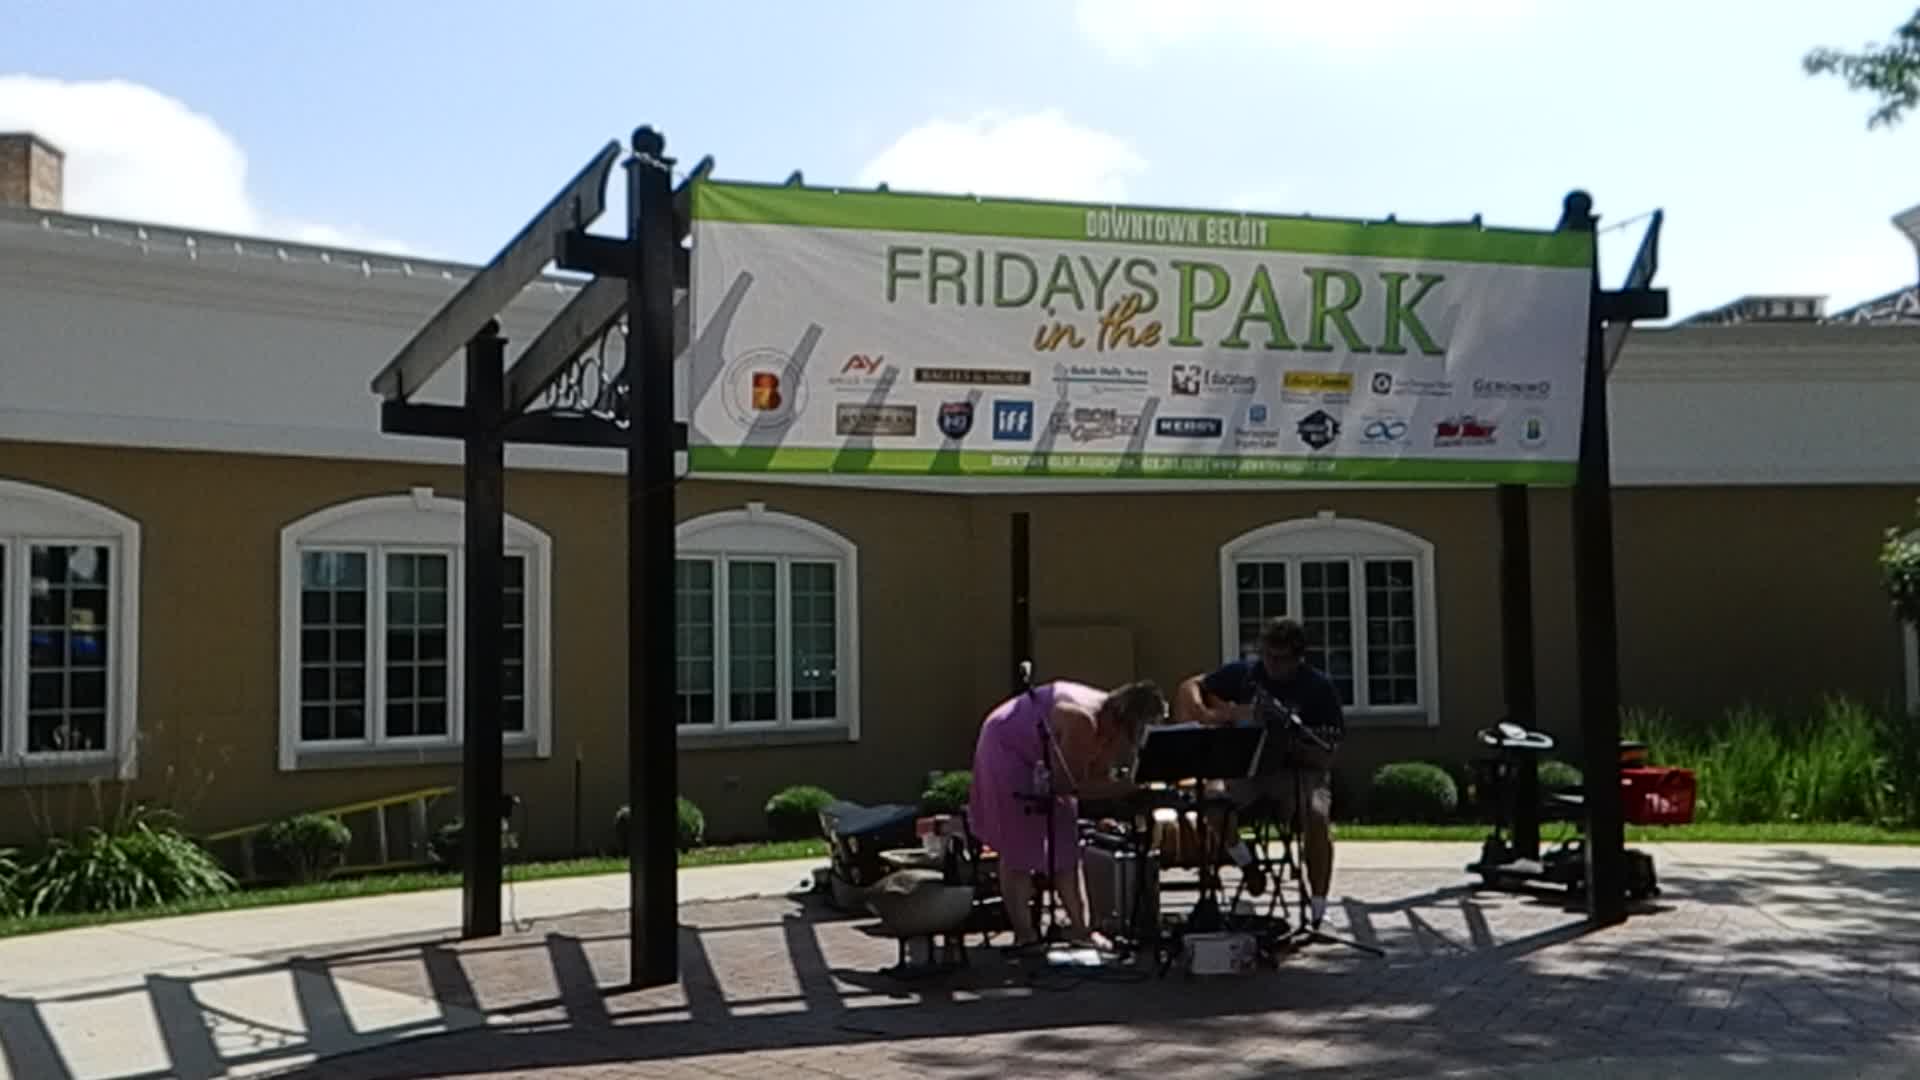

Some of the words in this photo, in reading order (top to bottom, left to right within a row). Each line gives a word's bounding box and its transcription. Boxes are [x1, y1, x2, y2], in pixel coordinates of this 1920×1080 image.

[1085, 208, 1199, 242] DOWNTOWN
[1206, 221, 1268, 246] BELOIT
[885, 245, 1160, 315] FRIDAYS
[1168, 259, 1446, 355] PARK
[1034, 308, 1087, 352] in
[1097, 293, 1162, 352] the
[998, 410, 1029, 432] iff
